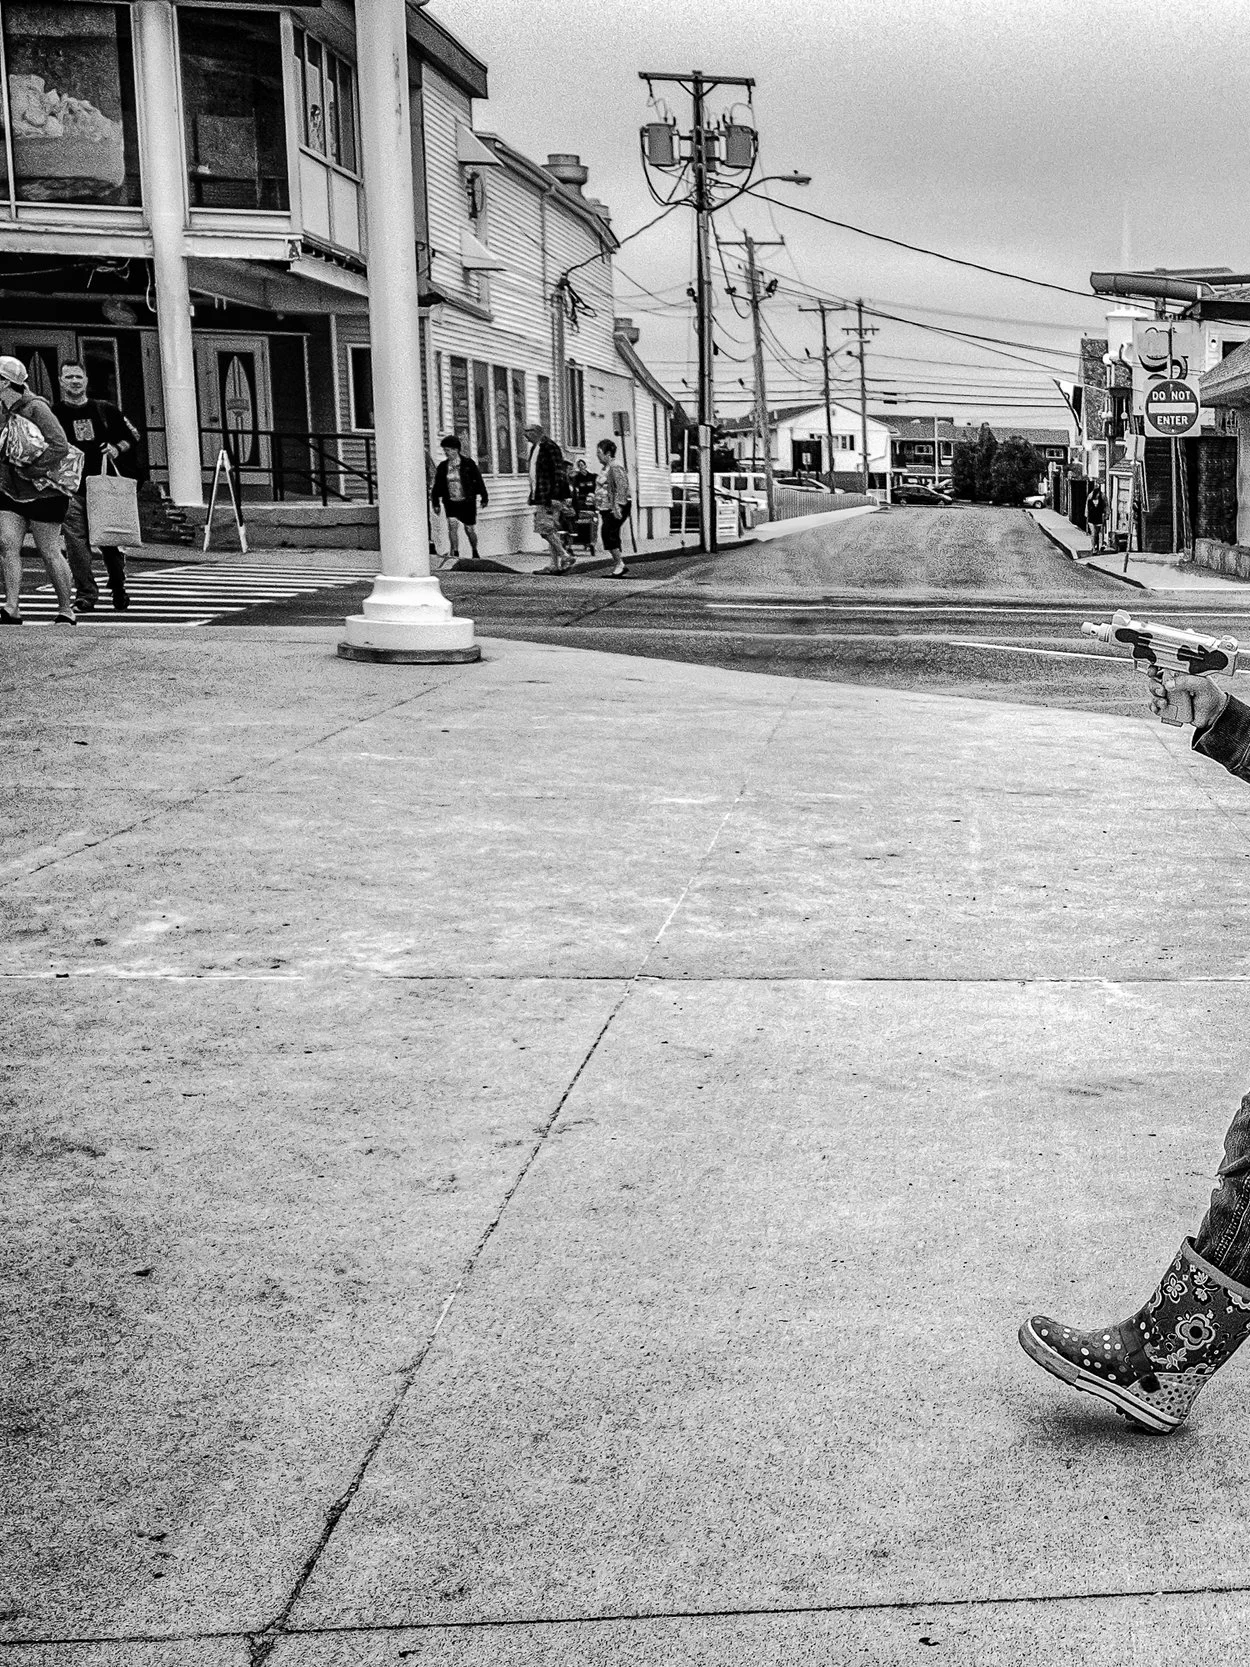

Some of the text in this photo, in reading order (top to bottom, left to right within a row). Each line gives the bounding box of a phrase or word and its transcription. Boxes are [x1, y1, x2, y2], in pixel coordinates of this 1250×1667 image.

[1152, 391, 1190, 400] DO NOT
[1157, 415, 1188, 425] ENTER
